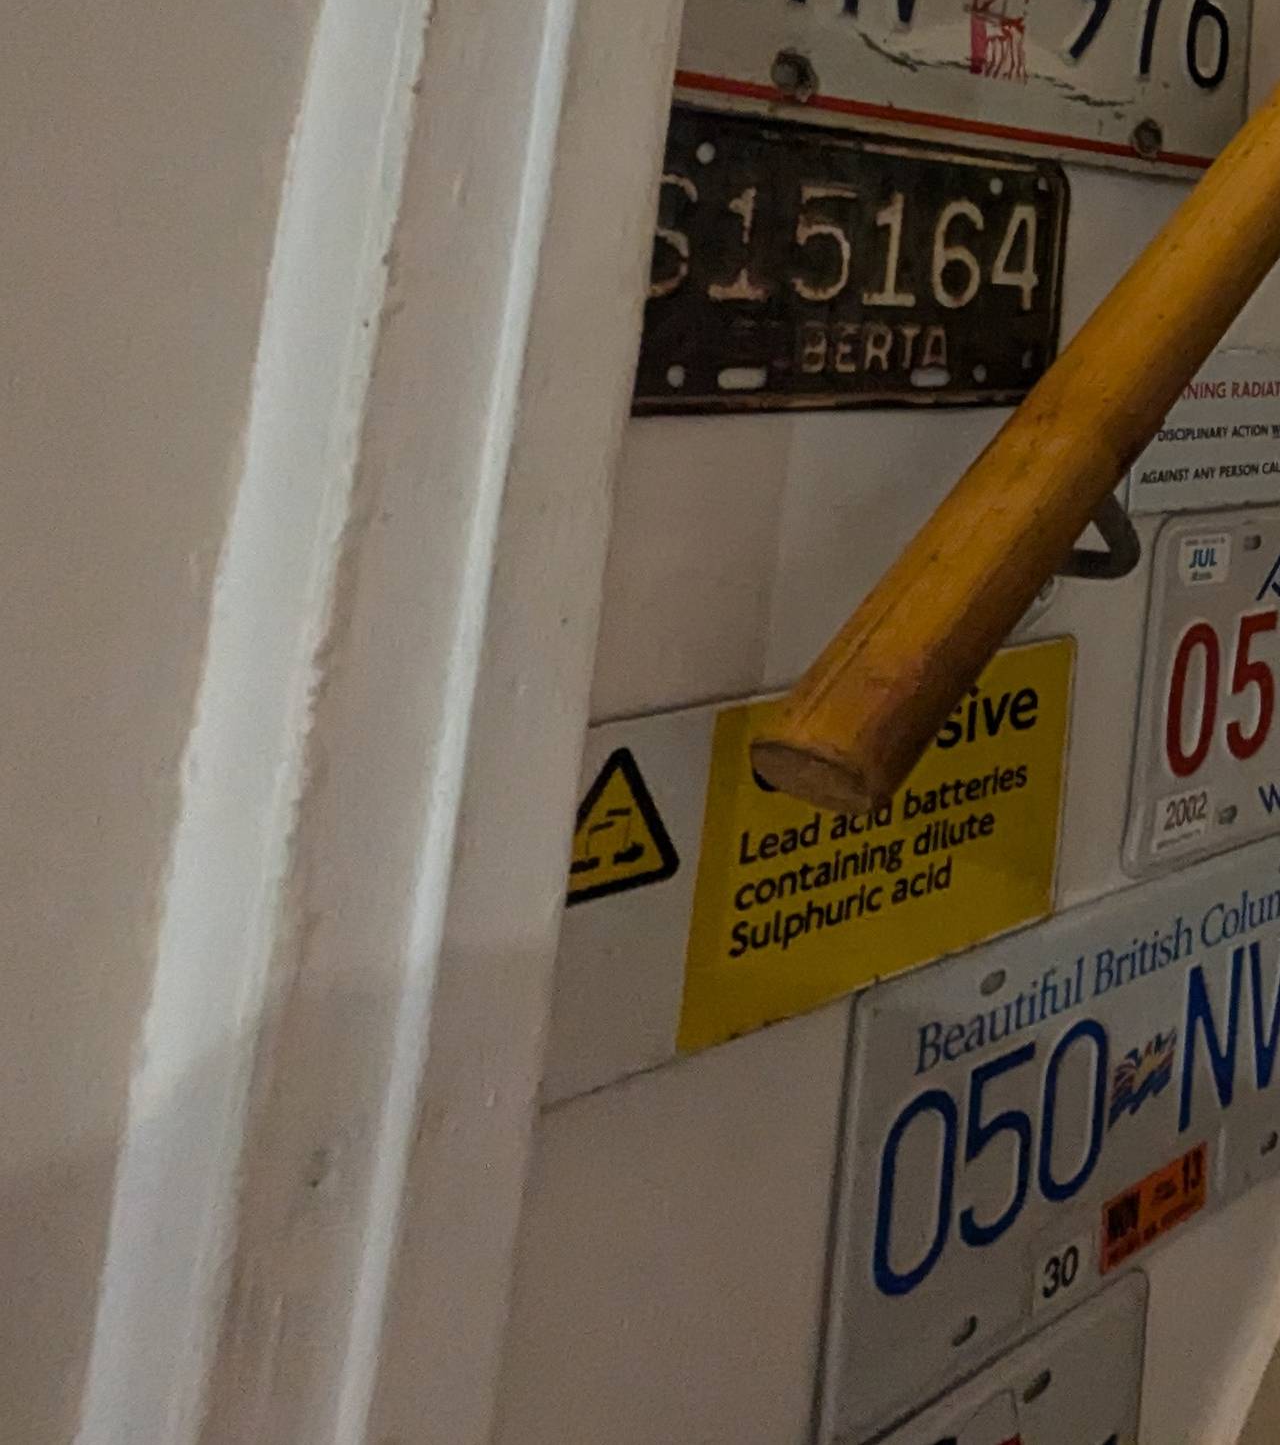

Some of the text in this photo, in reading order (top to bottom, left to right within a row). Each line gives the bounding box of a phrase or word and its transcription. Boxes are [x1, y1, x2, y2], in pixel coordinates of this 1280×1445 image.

[1157, 422, 1228, 443] DISCIPLINARY
[1231, 422, 1269, 440] ACTION
[1140, 465, 1188, 486] AGAINST
[1192, 463, 1217, 483] ANY
[1219, 460, 1260, 481] PERSON
[1188, 545, 1219, 569] JUL
[738, 763, 1028, 866] Lead acid batteries
[1163, 790, 1209, 833] 2002
[733, 811, 996, 913] containing dilute
[728, 857, 953, 960] Sulphuric acid
[915, 971, 1087, 1076] Beautiful
[1092, 917, 1194, 998] British
[872, 1017, 1109, 1298] 050
[1041, 1244, 1080, 1301] 30
